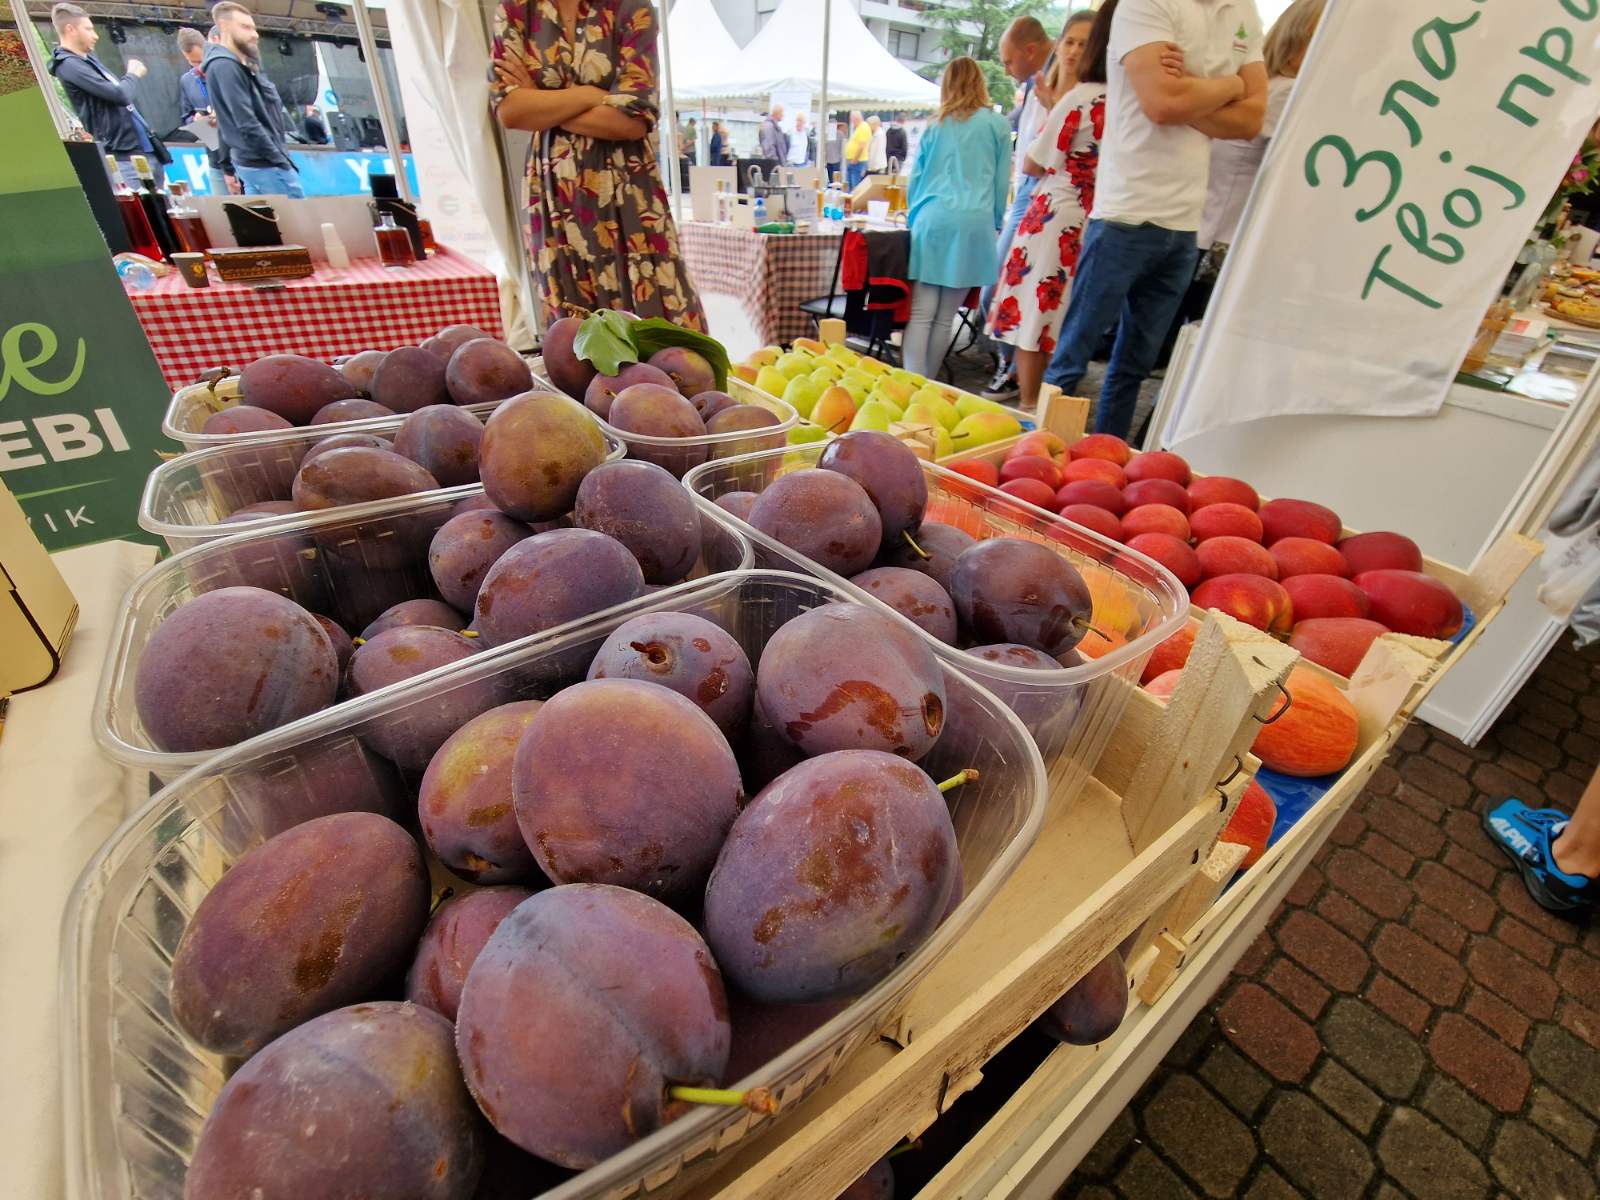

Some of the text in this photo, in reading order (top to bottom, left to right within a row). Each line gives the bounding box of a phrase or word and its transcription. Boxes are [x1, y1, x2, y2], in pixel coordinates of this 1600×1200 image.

[1305, 0, 1490, 222] Зла
[1361, 150, 1526, 309] Твој
[27, 505, 96, 533] IK
